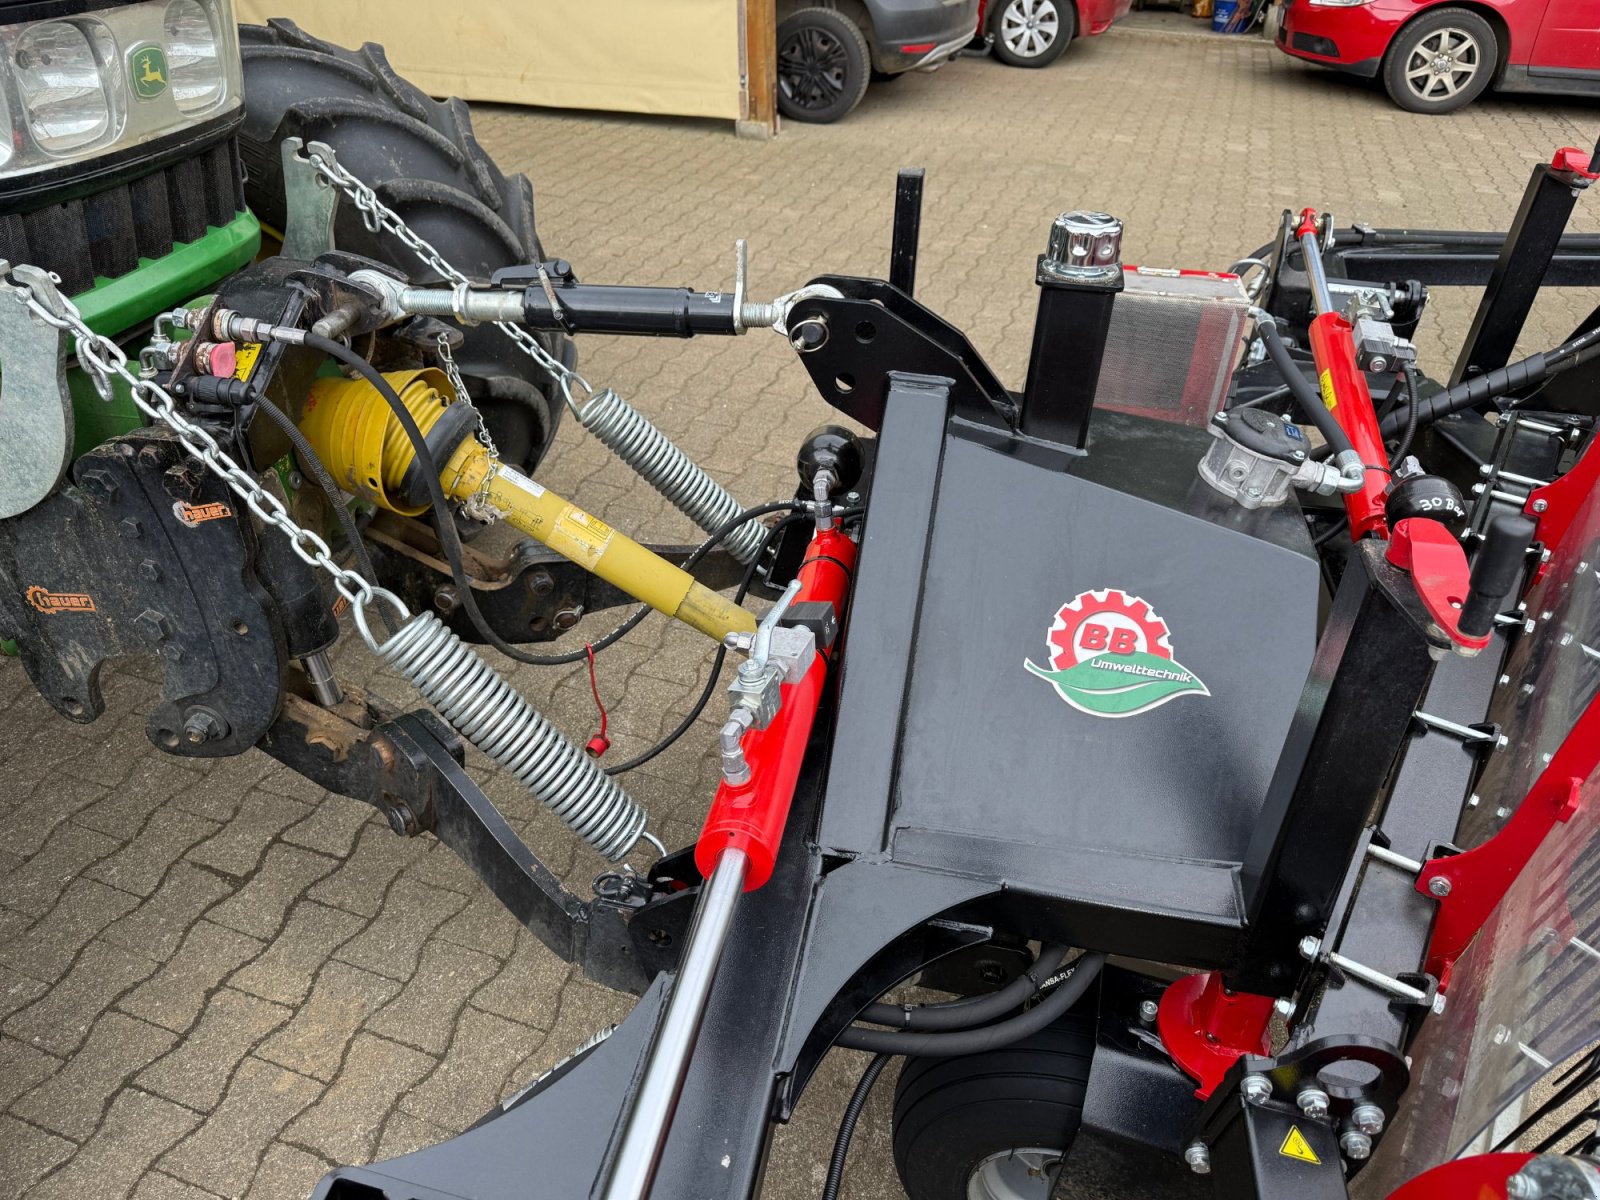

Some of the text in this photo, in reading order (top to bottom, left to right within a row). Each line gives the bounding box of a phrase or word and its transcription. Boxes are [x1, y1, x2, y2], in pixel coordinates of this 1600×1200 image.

[1419, 497, 1442, 511] 30
[34, 590, 89, 608] hauer
[1079, 623, 1137, 654] BB
[1090, 657, 1193, 683] Umwelttechnik
